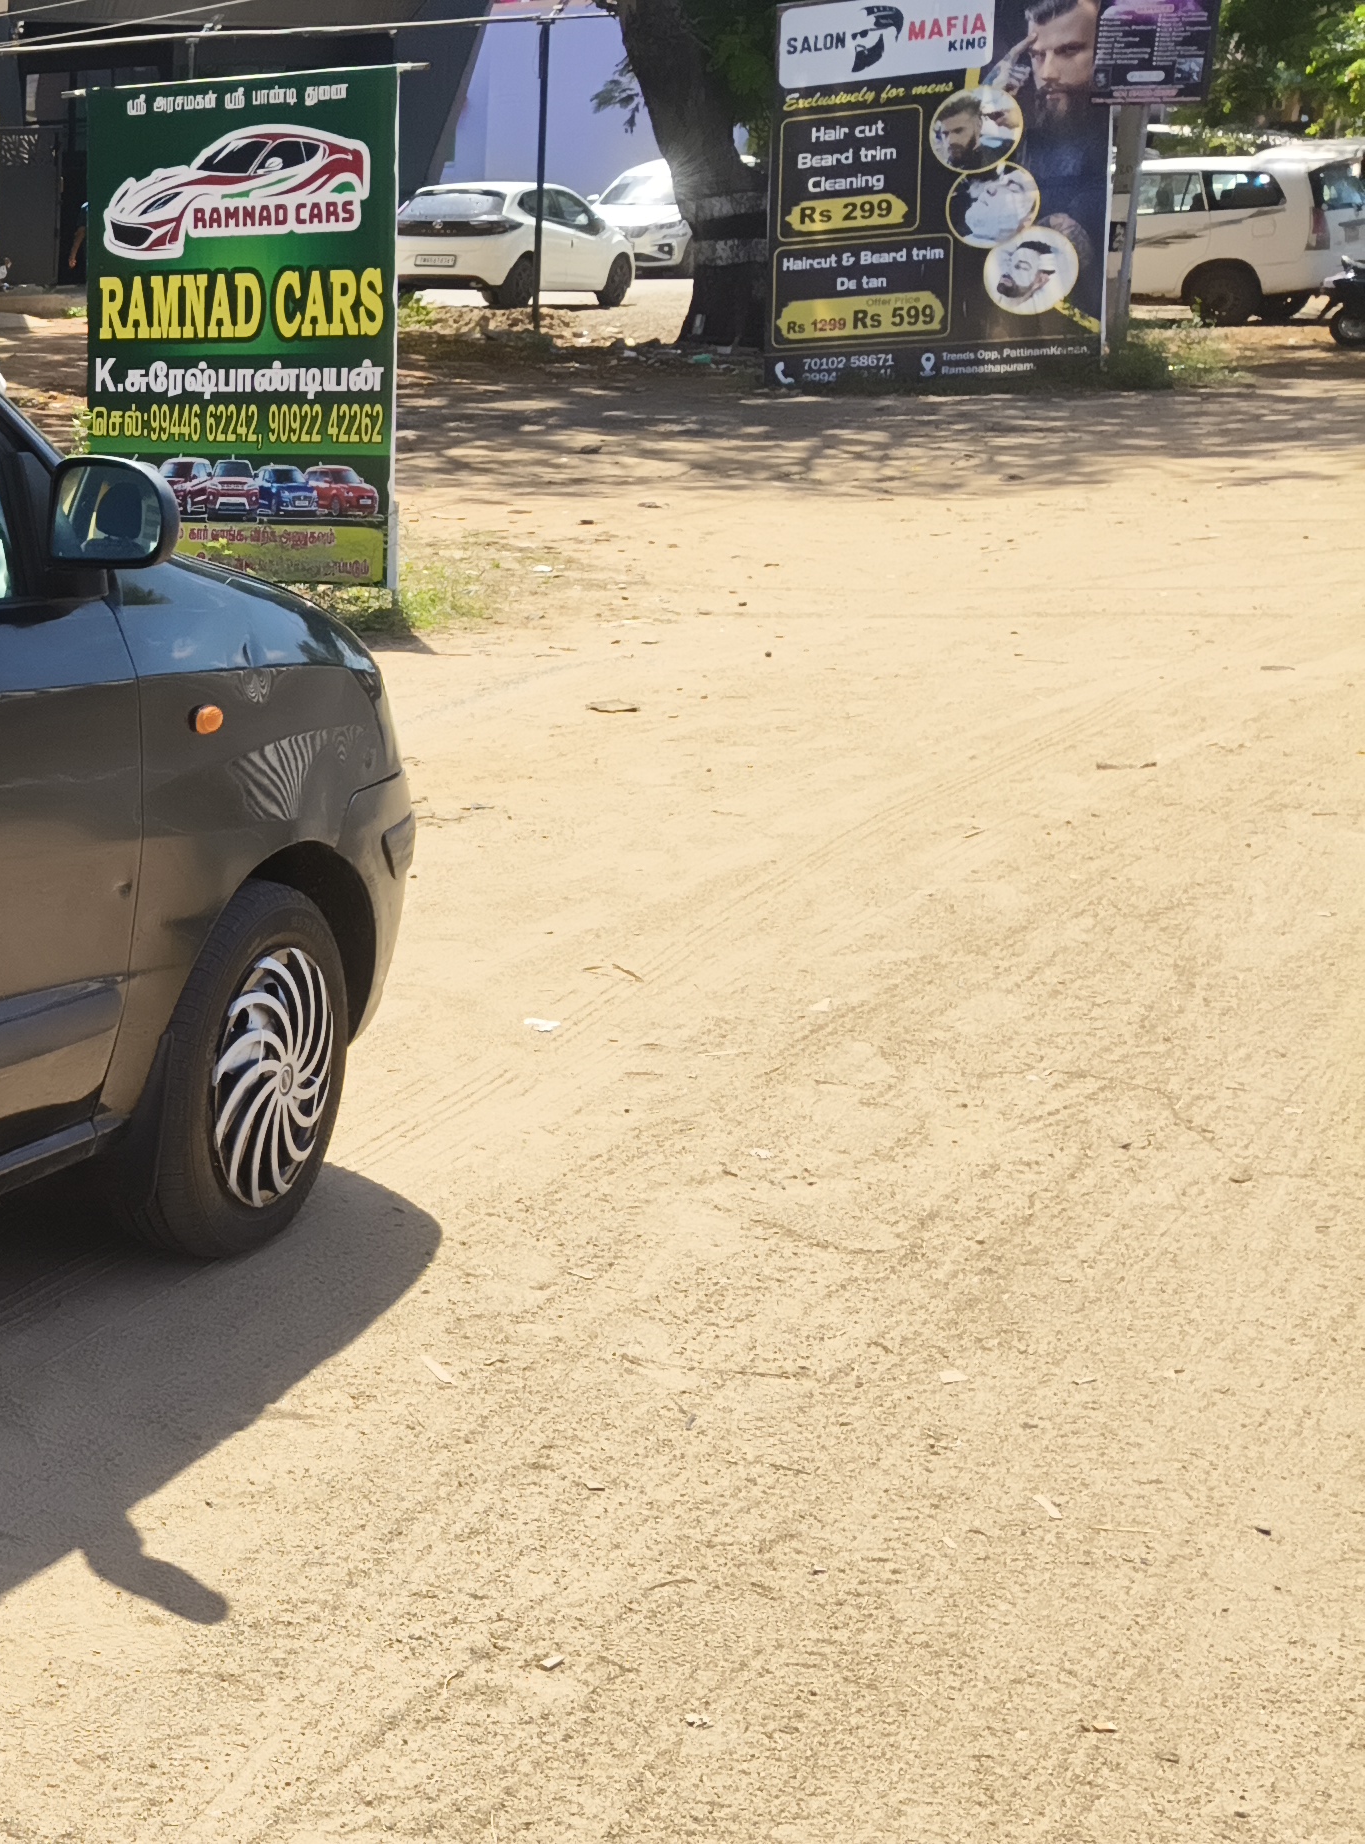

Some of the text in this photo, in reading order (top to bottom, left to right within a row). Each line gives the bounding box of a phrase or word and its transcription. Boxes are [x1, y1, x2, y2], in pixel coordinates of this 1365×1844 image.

[907, 13, 987, 42] MAFIA
[786, 31, 847, 55] SALON
[947, 36, 987, 53] KING
[252, 85, 298, 105] பாண்டி
[783, 81, 954, 111] Exclusively for mens
[810, 120, 885, 143] Hair cut
[797, 145, 897, 169] Beard trim
[807, 172, 885, 194] Cleaning
[193, 200, 356, 230] RAMNAD CARS
[799, 199, 893, 225] Rs 299
[782, 246, 945, 272] Haircut & Beard trim
[836, 276, 887, 291] De tan
[99, 267, 384, 340] RAMNAD CARS
[786, 303, 936, 335] Rs 1299 Rs 599
[802, 353, 895, 371] 70102 58671
[942, 351, 975, 361] Trends
[268, 403, 322, 443] 90922
[327, 403, 383, 443] 42262
